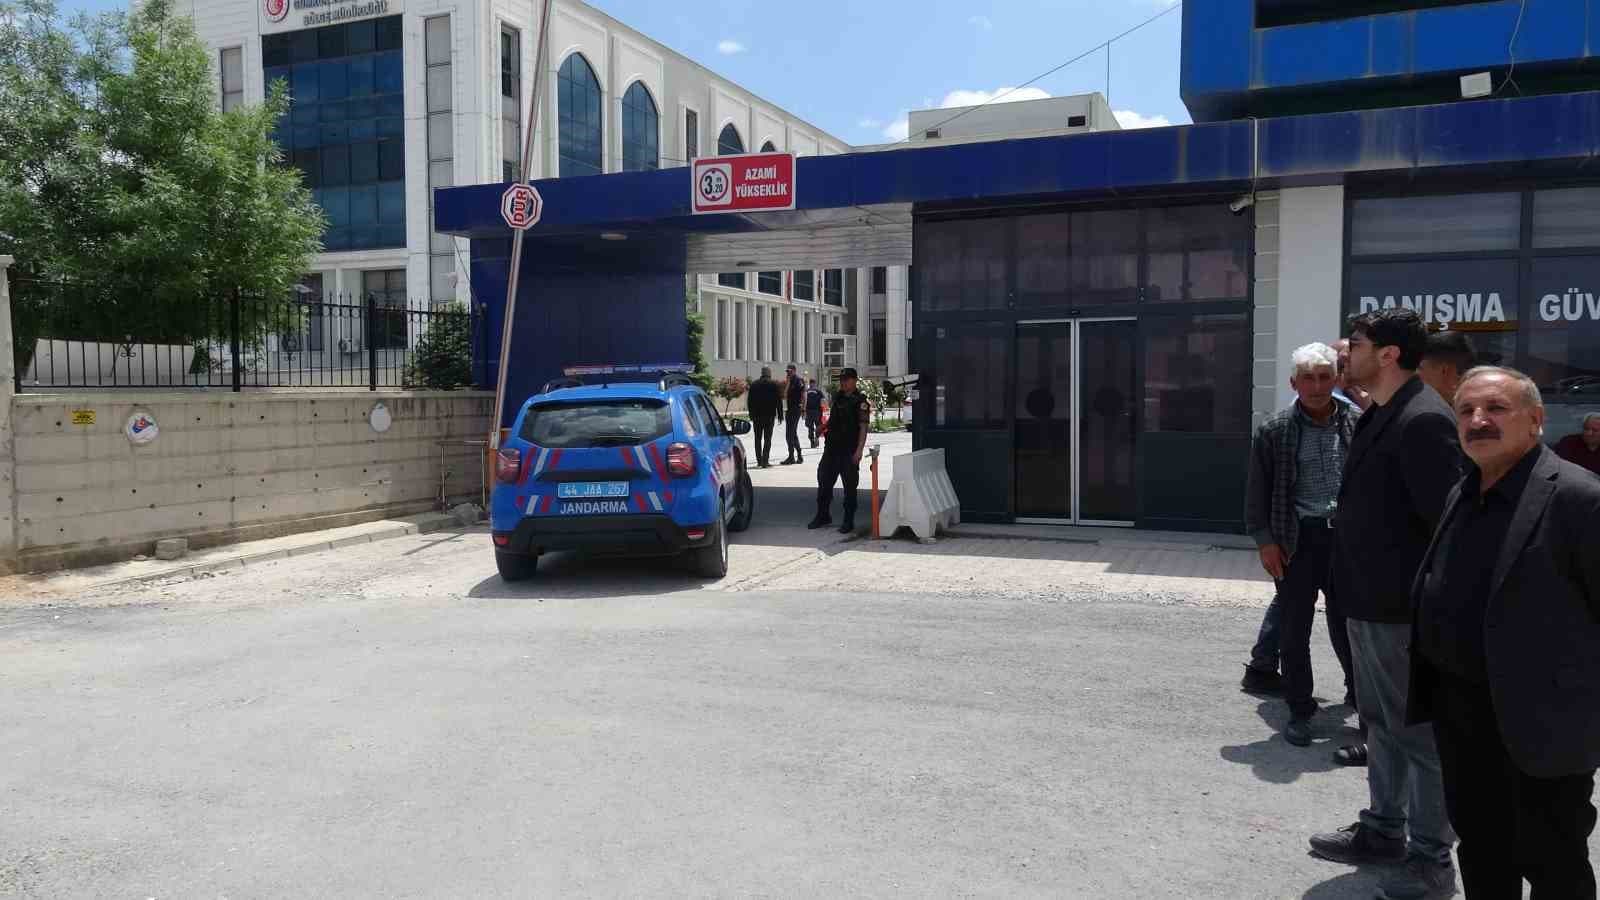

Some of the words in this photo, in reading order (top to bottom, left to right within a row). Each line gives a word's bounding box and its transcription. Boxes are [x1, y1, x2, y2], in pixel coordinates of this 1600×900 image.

[744, 164, 777, 180] AZAMİ
[735, 181, 788, 198] YÜKSEKLİK
[513, 190, 527, 222] DUR
[1539, 288, 1600, 322] GÜV
[584, 484, 602, 496] JAA
[560, 501, 628, 514] JANDARMA
